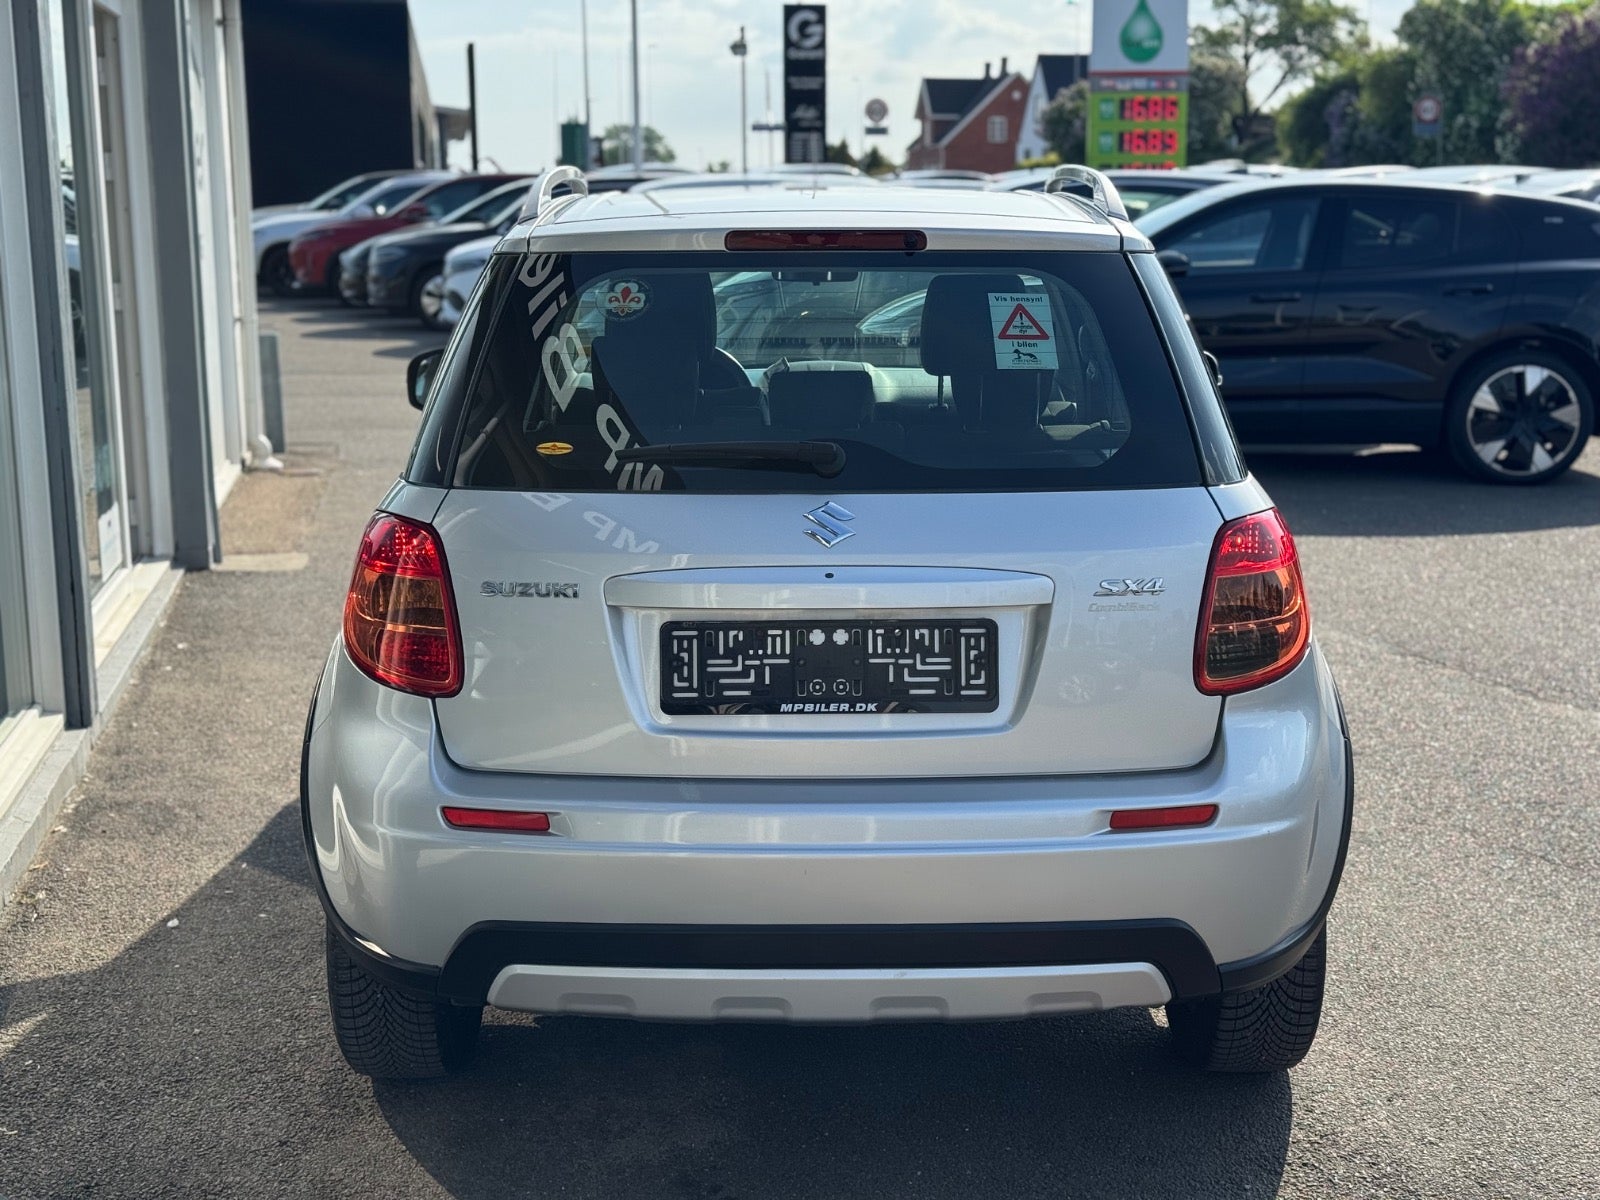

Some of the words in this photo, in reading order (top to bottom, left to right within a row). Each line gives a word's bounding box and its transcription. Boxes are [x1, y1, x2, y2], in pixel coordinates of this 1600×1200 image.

[1122, 95, 1179, 122] 1686
[1122, 128, 1179, 155] 1689
[1010, 295, 1043, 304] hensyn!
[480, 581, 580, 598] SUZUKI
[1093, 577, 1167, 596] SX4
[779, 703, 879, 713] MPBILER.DK
